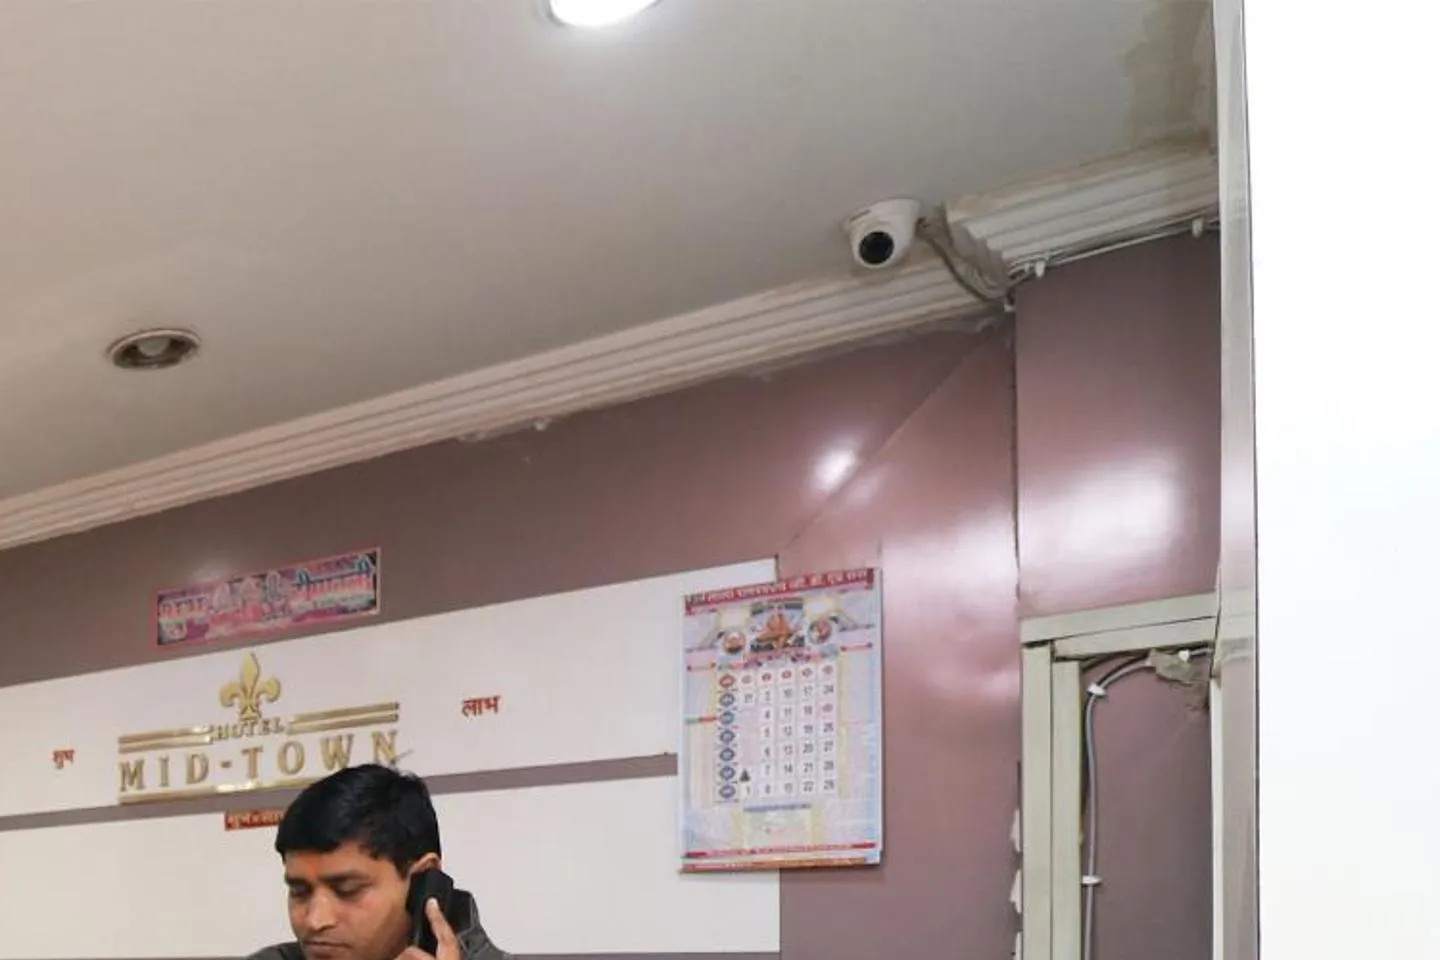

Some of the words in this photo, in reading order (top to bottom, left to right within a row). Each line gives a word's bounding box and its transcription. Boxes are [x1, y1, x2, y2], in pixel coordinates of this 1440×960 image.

[461, 696, 500, 717] लाभ
[215, 717, 285, 741] HOTEL
[119, 731, 399, 792] MID-TOWN
